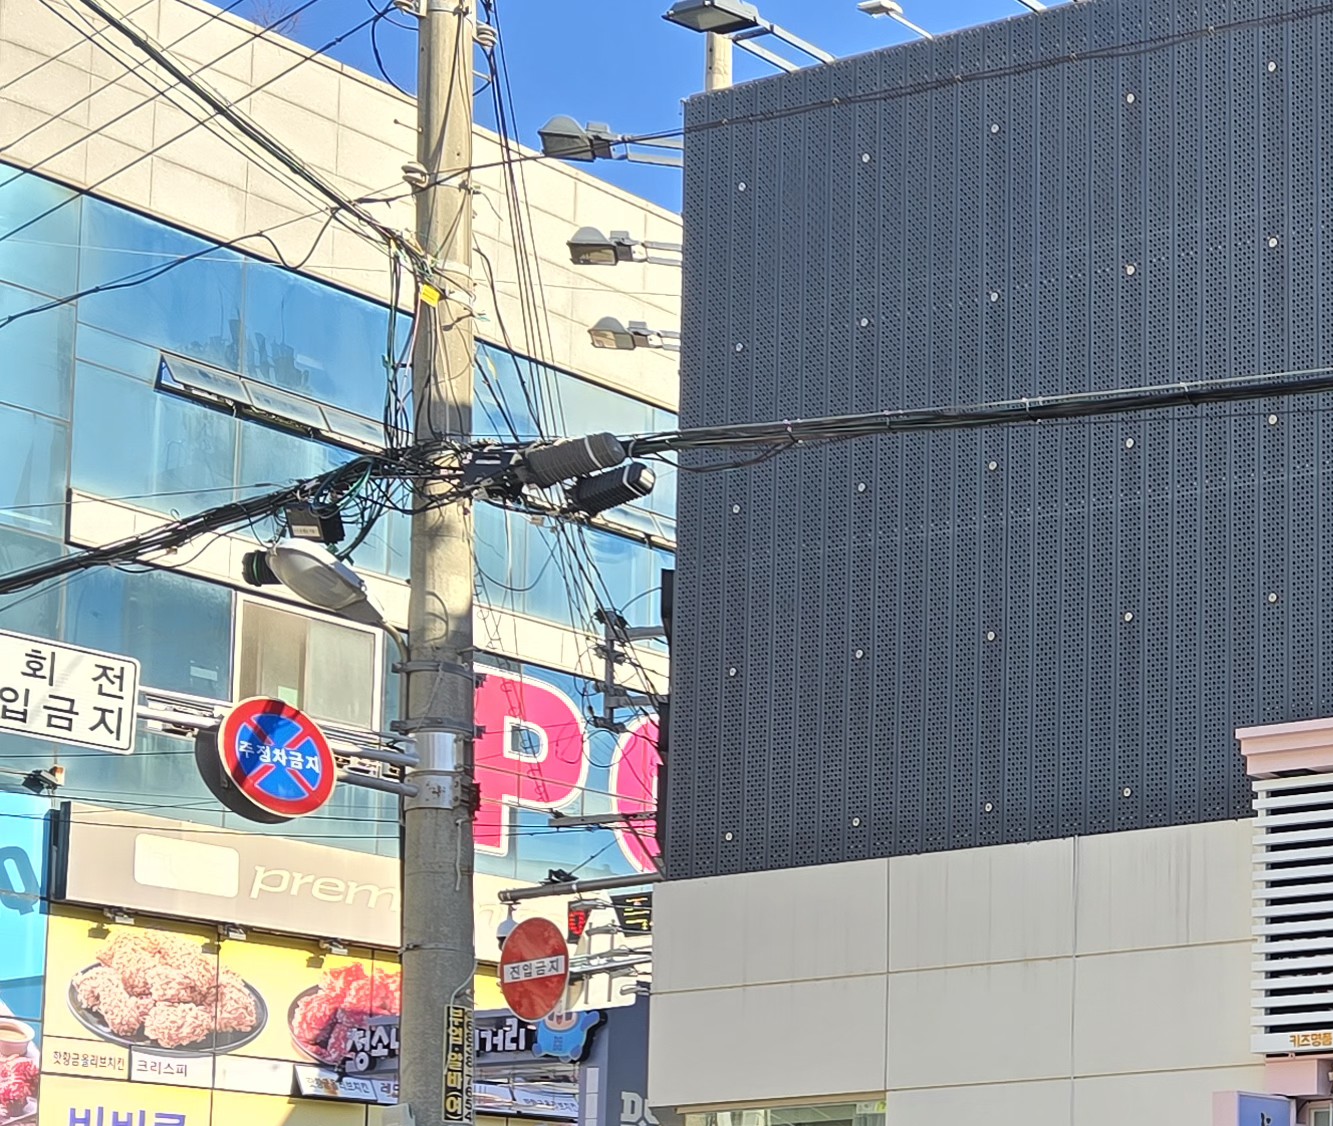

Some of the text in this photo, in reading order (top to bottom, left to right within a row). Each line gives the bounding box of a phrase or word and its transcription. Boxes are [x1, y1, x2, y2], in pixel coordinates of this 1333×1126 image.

[238, 739, 321, 774] 주정차금지
[509, 957, 560, 980] 진입금지
[136, 1059, 189, 1077] 크리스피
